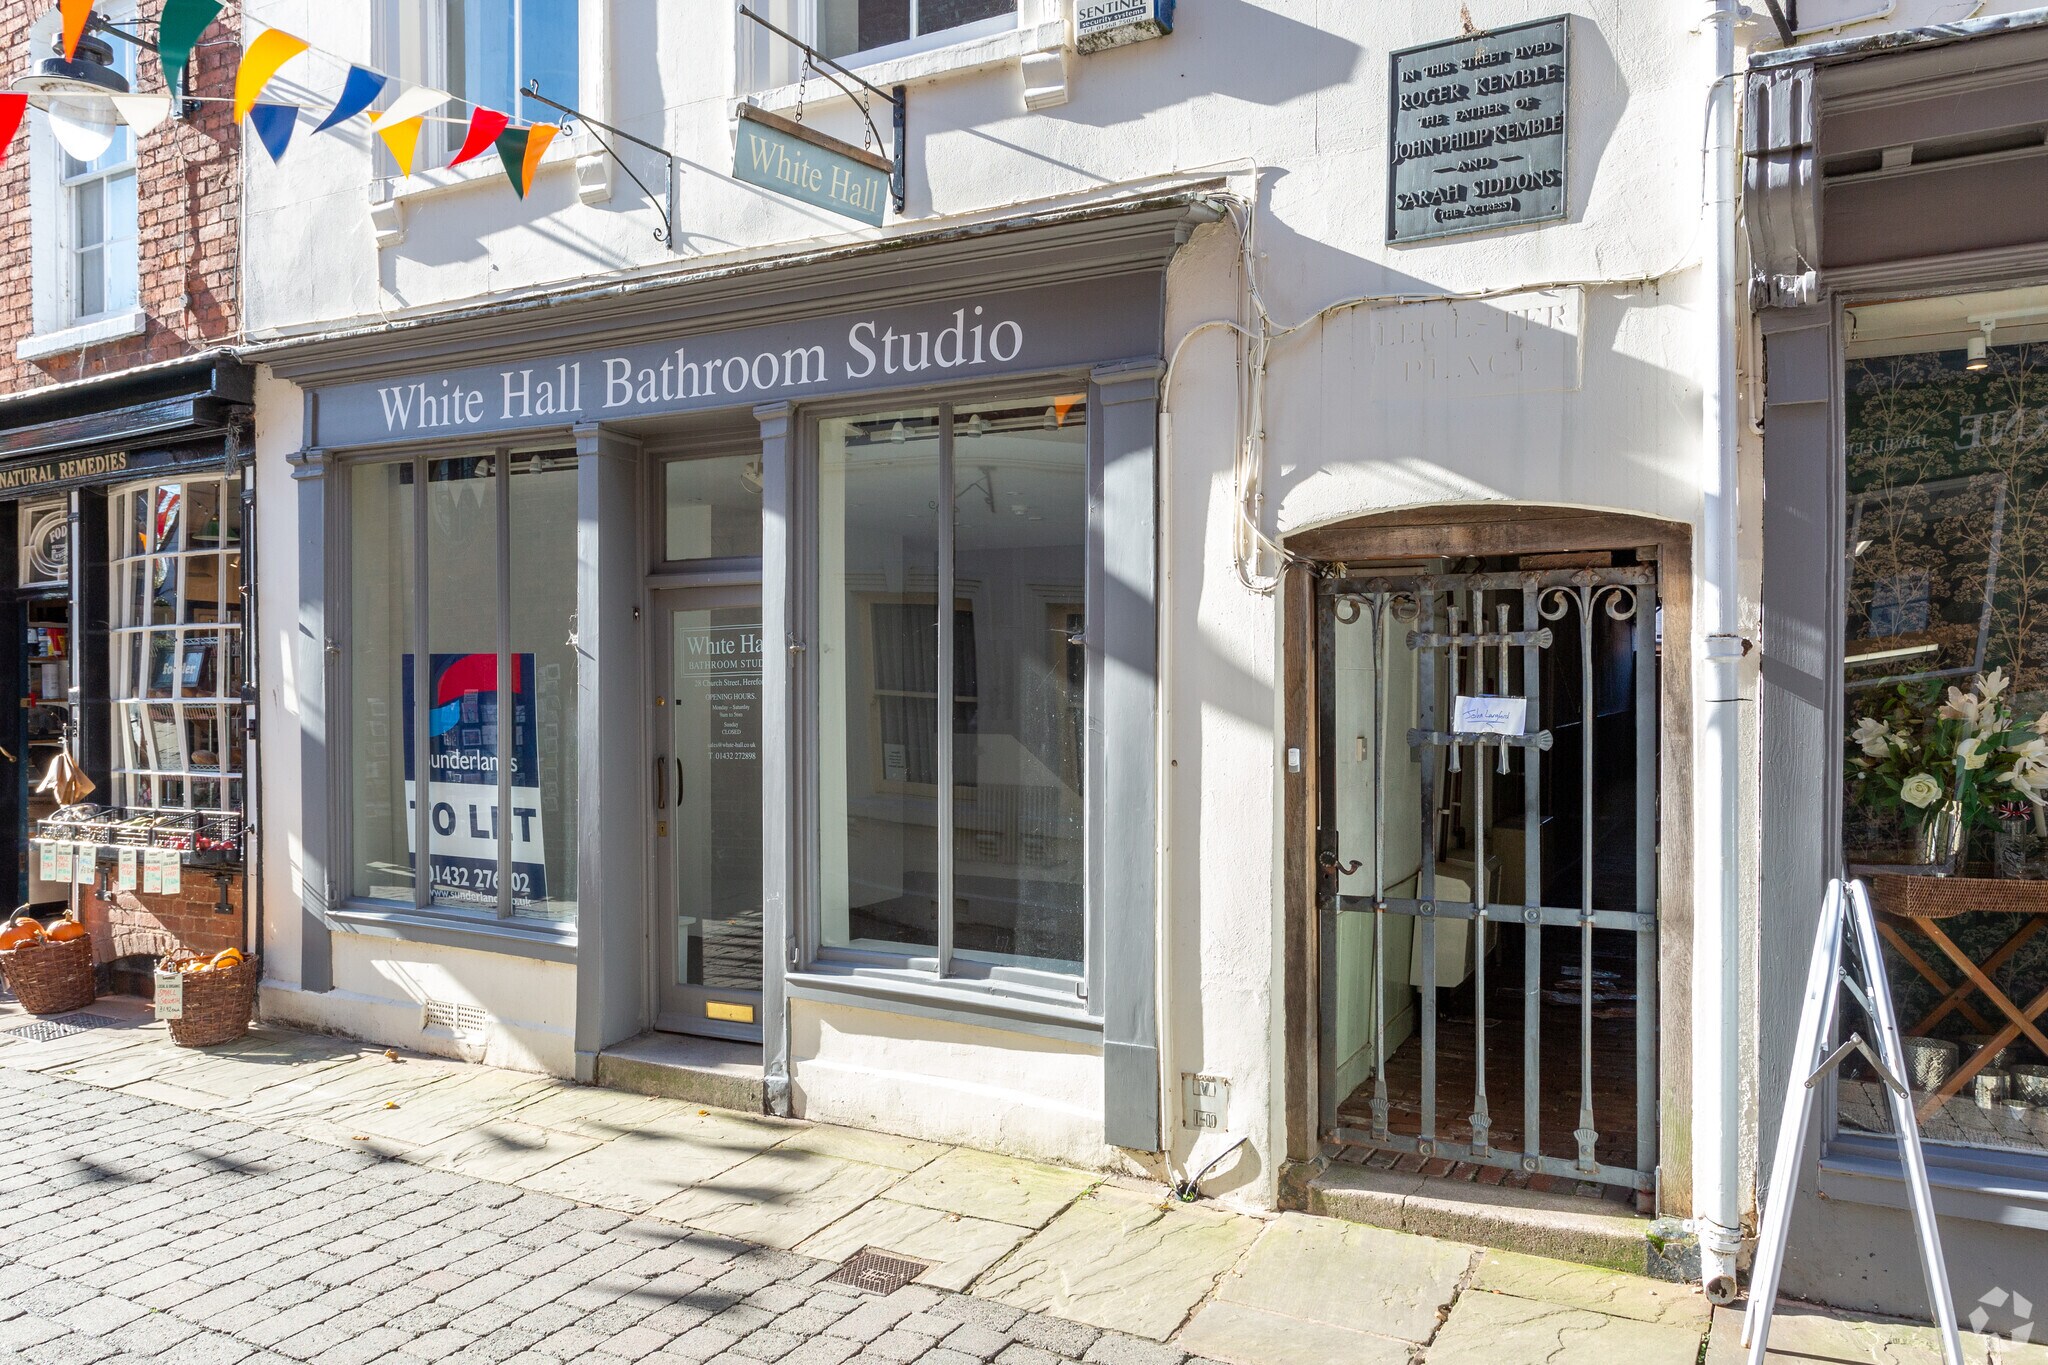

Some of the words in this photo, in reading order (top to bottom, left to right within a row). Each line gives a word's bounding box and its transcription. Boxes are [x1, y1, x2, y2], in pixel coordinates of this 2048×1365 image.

[1082, 15, 1113, 28] security
[1114, 7, 1144, 20] systems
[1401, 70, 1415, 82] IN
[1423, 63, 1451, 78] THIS
[1460, 53, 1504, 69] STREET
[1514, 42, 1554, 59] LIVED
[1399, 83, 1462, 109] ROGER
[1475, 65, 1555, 95] KEMBLE
[1417, 115, 1443, 128] THE
[1454, 103, 1503, 122] FATHER
[1514, 97, 1533, 109] OF
[1392, 138, 1434, 164] JOHN
[1440, 128, 1490, 153] PHILIP
[1492, 114, 1562, 143] KEMBLE
[749, 133, 822, 192] White
[829, 165, 878, 213] Hall
[1457, 157, 1491, 172] AND
[1396, 184, 1460, 209] SARAH
[1473, 169, 1556, 197] SIDDONS
[377, 378, 484, 432] White
[500, 362, 583, 420] Hall
[602, 348, 828, 409] Bathroom
[846, 305, 1024, 380] Studio
[0, 464, 55, 488] NATURAL
[58, 452, 127, 479] REMEDIES
[686, 635, 736, 655] White
[689, 660, 738, 670] BATHROOM
[703, 679, 723, 687] Church
[705, 693, 732, 701] OPENING
[429, 749, 518, 772] underlans
[469, 804, 536, 843] LT
[473, 869, 531, 893] 27602
